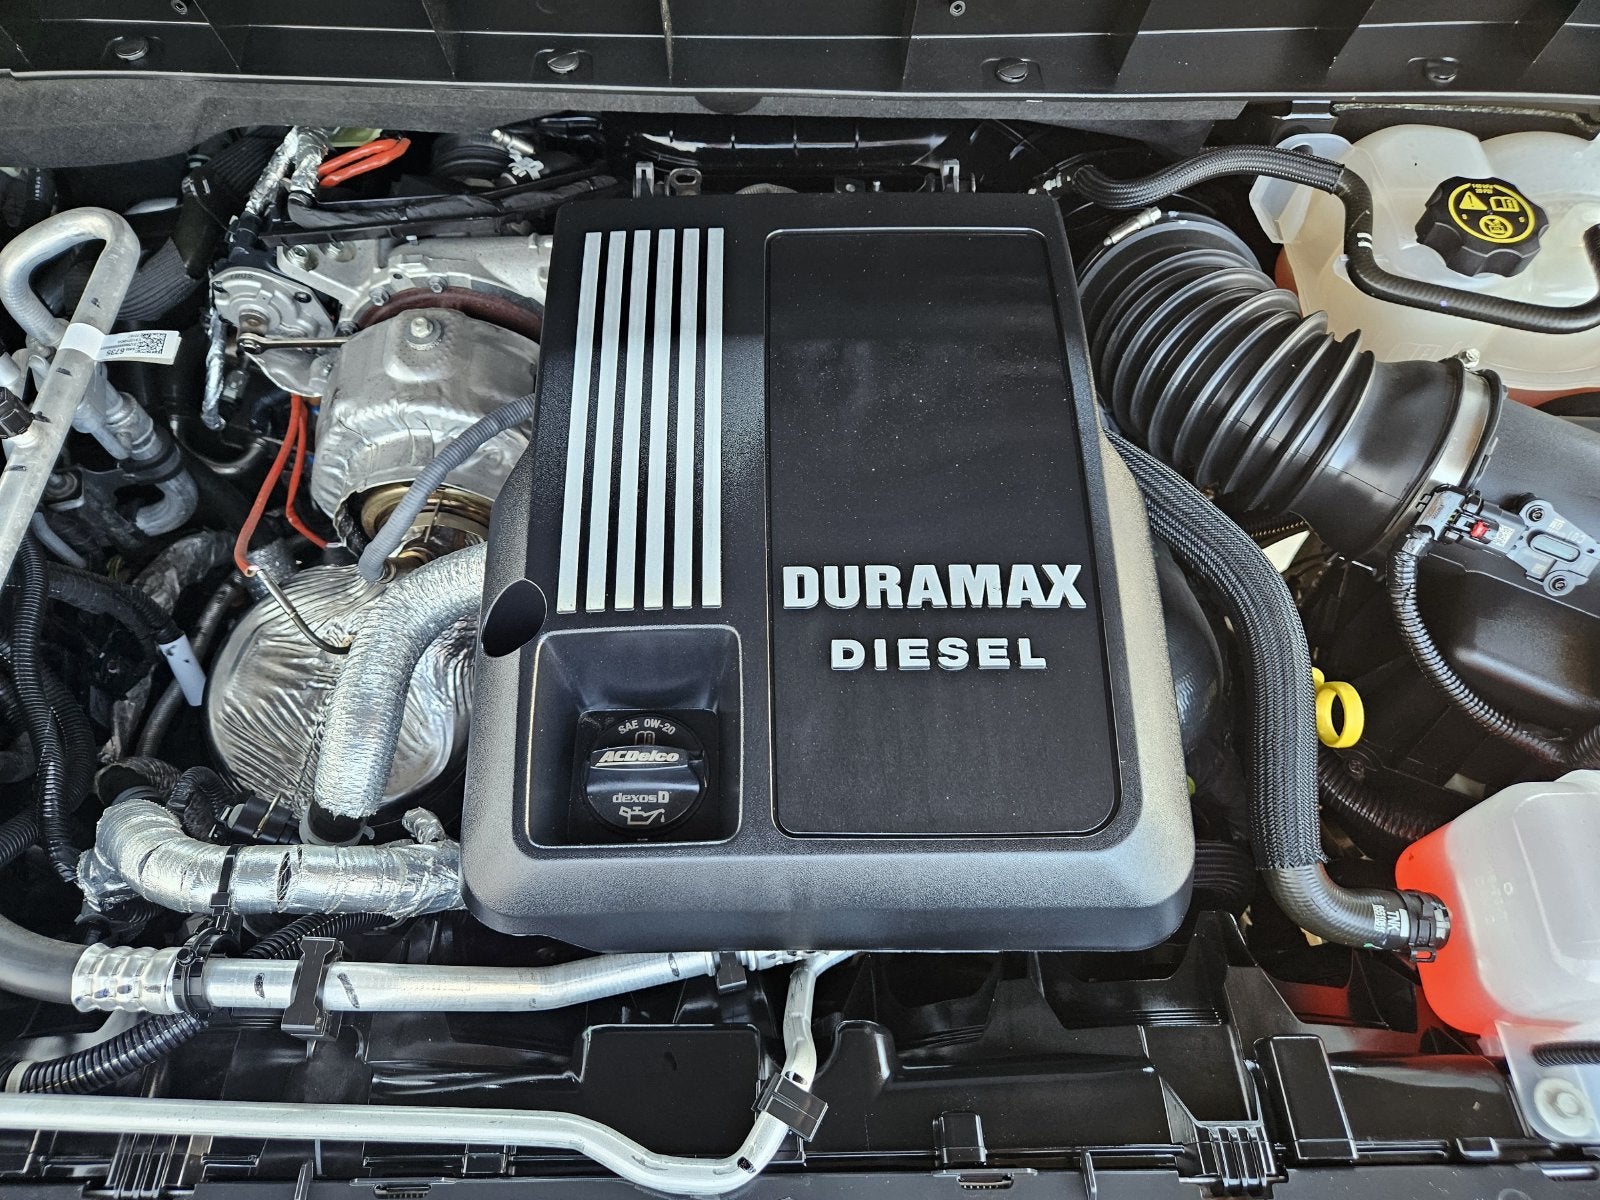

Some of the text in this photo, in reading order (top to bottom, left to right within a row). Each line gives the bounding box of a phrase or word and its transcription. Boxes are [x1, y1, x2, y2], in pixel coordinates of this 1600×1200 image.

[782, 564, 1087, 609] DURAMAX
[830, 637, 1047, 671] DIESEL
[618, 719, 676, 735] SAE 0W-20
[598, 750, 680, 763] ACDelco
[1387, 911, 1400, 931] TNK
